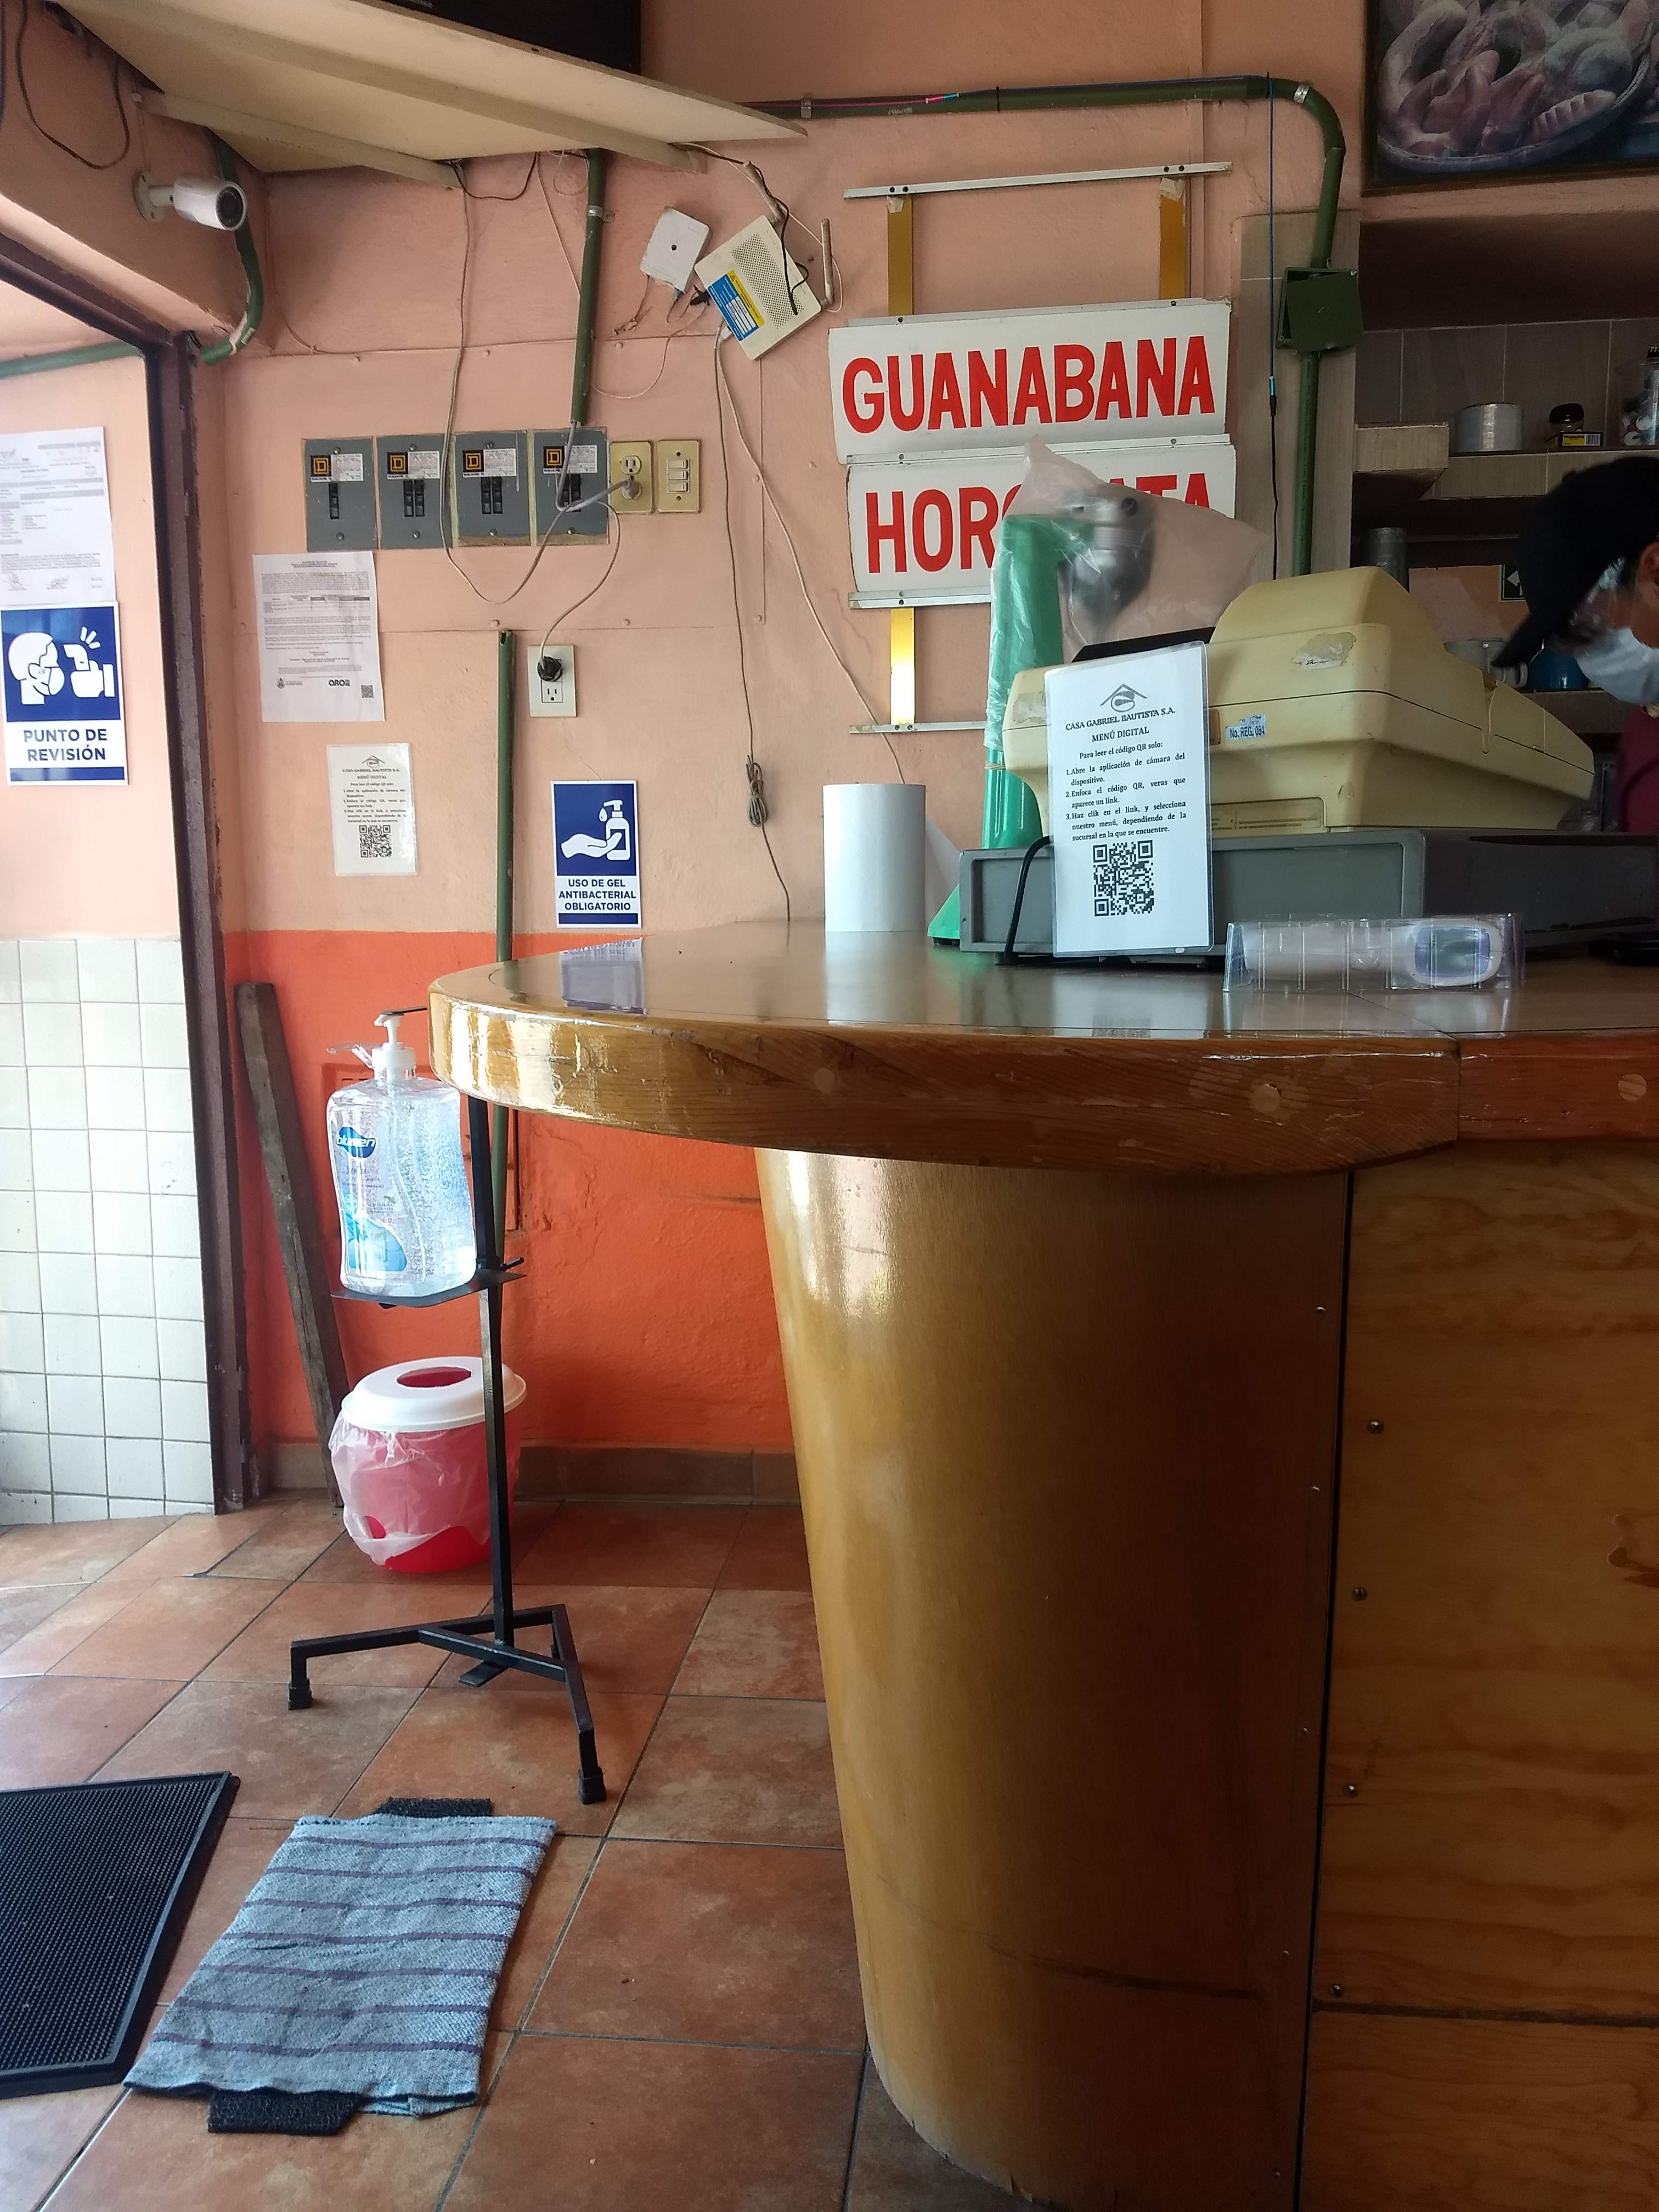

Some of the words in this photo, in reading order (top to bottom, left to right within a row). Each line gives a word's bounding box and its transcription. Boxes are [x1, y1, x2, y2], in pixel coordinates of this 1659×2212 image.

[843, 336, 1215, 433] GUANABANA
[865, 473, 1210, 573] HORT
[1065, 721, 1085, 731] CASA
[1086, 716, 1120, 727] GABRIEL
[1121, 709, 1159, 722] BAUTISTA
[1161, 707, 1176, 715] S.A.
[24, 729, 80, 742] PUNTO
[86, 729, 107, 741] DE
[1092, 730, 1115, 742] MENÚ
[1117, 726, 1149, 738] DIGITAL
[1230, 728, 1239, 738] No.
[1240, 726, 1254, 737] REG.
[1255, 725, 1265, 736] 084
[27, 744, 106, 761] REVISIÓN
[1115, 746, 1136, 754] código
[1099, 761, 1130, 772] aplicación
[1147, 756, 1170, 764] cámara
[1175, 752, 1185, 760] del
[1071, 776, 1105, 786] dispositivo.
[1107, 785, 1127, 793] código
[1132, 782, 1144, 790] QR,
[1071, 800, 1094, 809] aparece
[1153, 801, 1186, 810] selecciona
[1099, 819, 1118, 827] menú,
[1122, 815, 1163, 825] dependiendo
[1072, 832, 1097, 841] sucursal
[1136, 826, 1170, 834] encuentre.
[568, 879, 589, 887] USO
[607, 879, 625, 887] GEL
[558, 890, 636, 899] ANTIBACTERIAL
[565, 902, 631, 911] OBLIGATORIO
